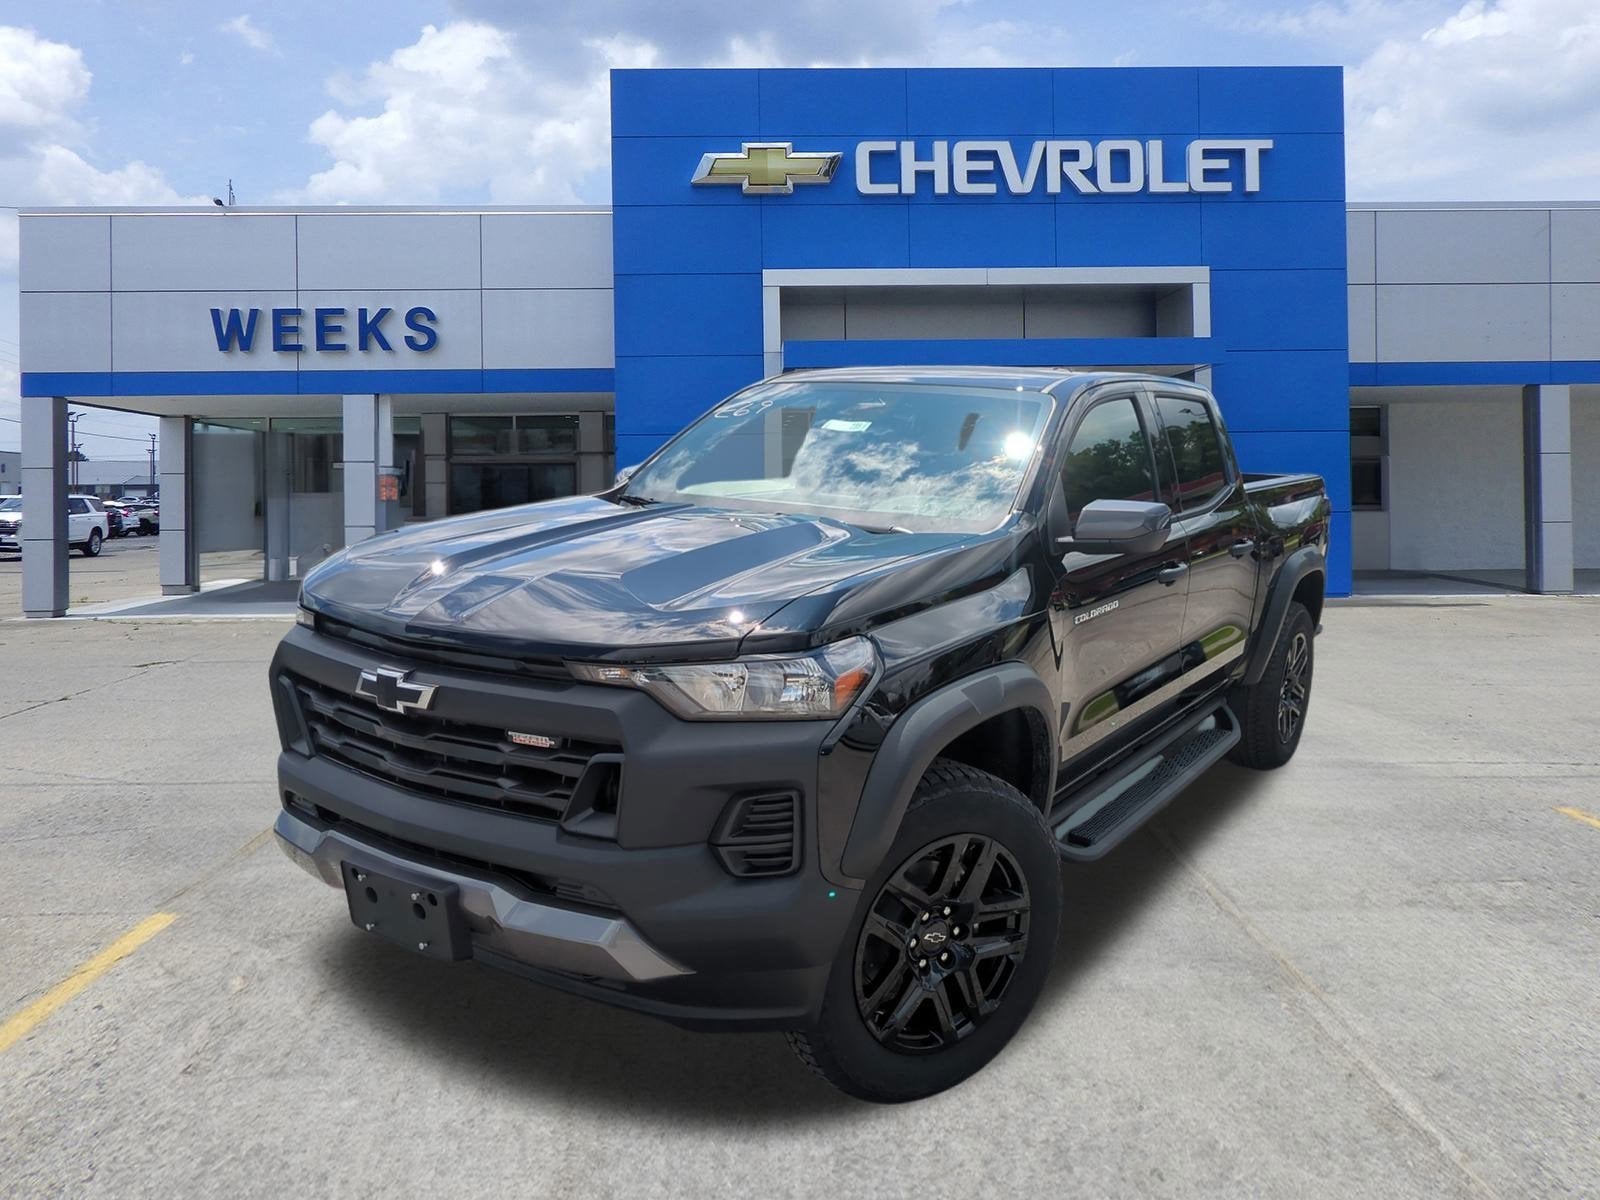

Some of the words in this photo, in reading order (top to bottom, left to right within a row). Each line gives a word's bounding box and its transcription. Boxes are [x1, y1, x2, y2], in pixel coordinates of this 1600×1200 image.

[855, 138, 1274, 195] CHEVROLET
[210, 305, 439, 353] WEEKS
[1074, 600, 1119, 625] COLORADO
